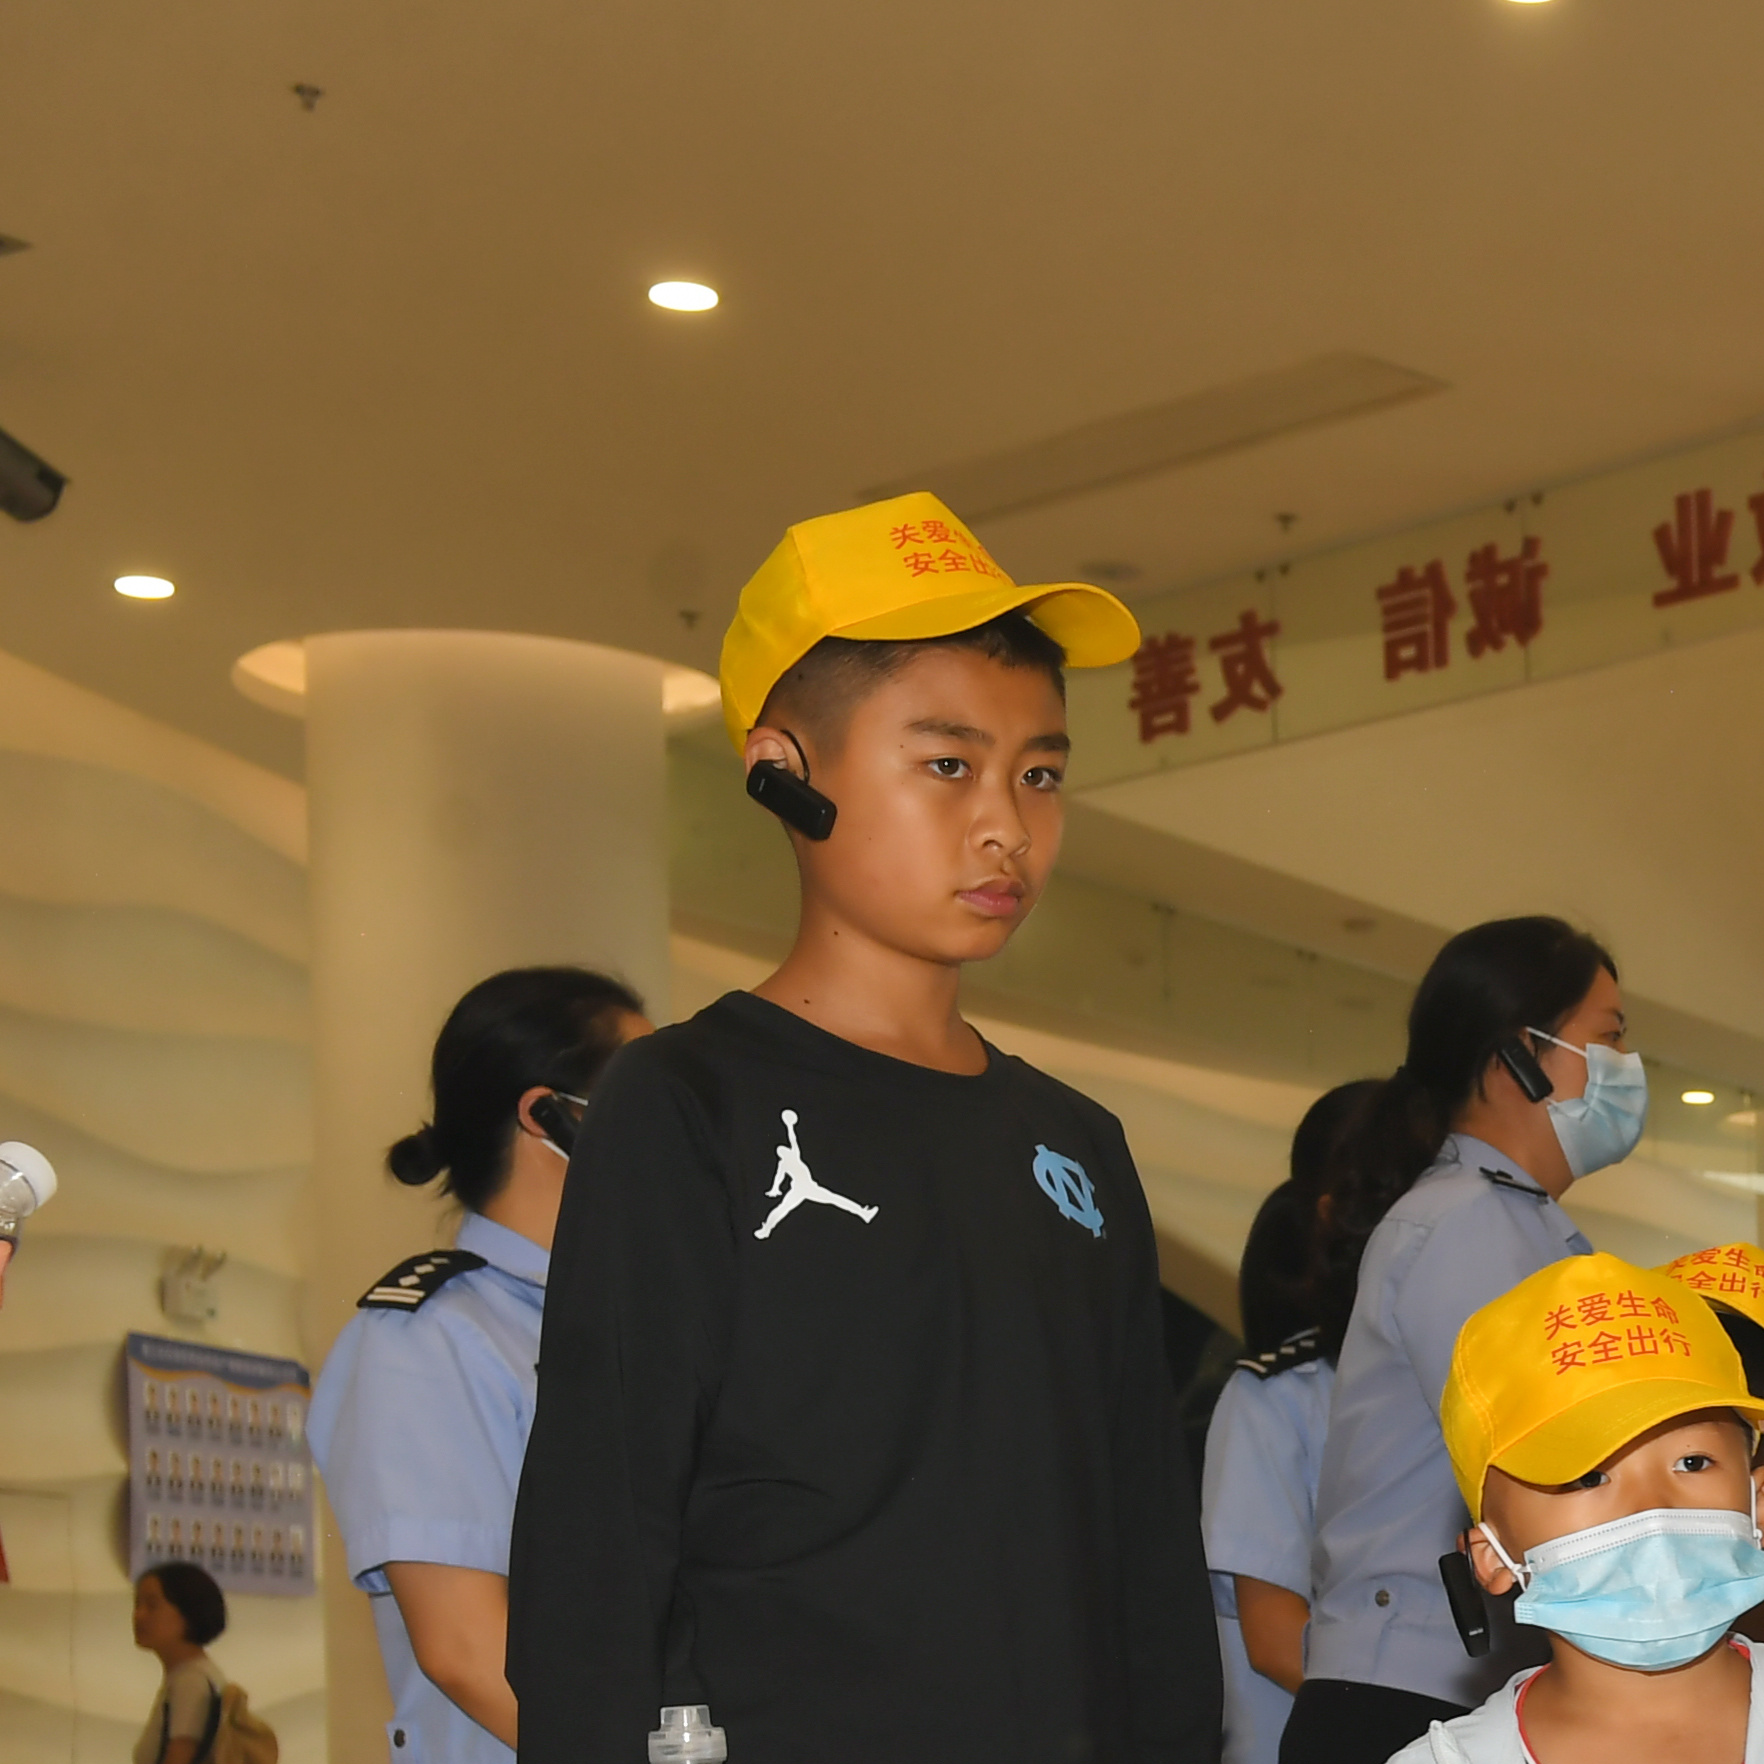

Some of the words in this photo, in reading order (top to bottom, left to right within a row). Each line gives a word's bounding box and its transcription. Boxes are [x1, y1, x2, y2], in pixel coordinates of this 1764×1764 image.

[1544, 1290, 1680, 1341] 关爱生命
[1551, 1324, 1692, 1376] 安全出行
